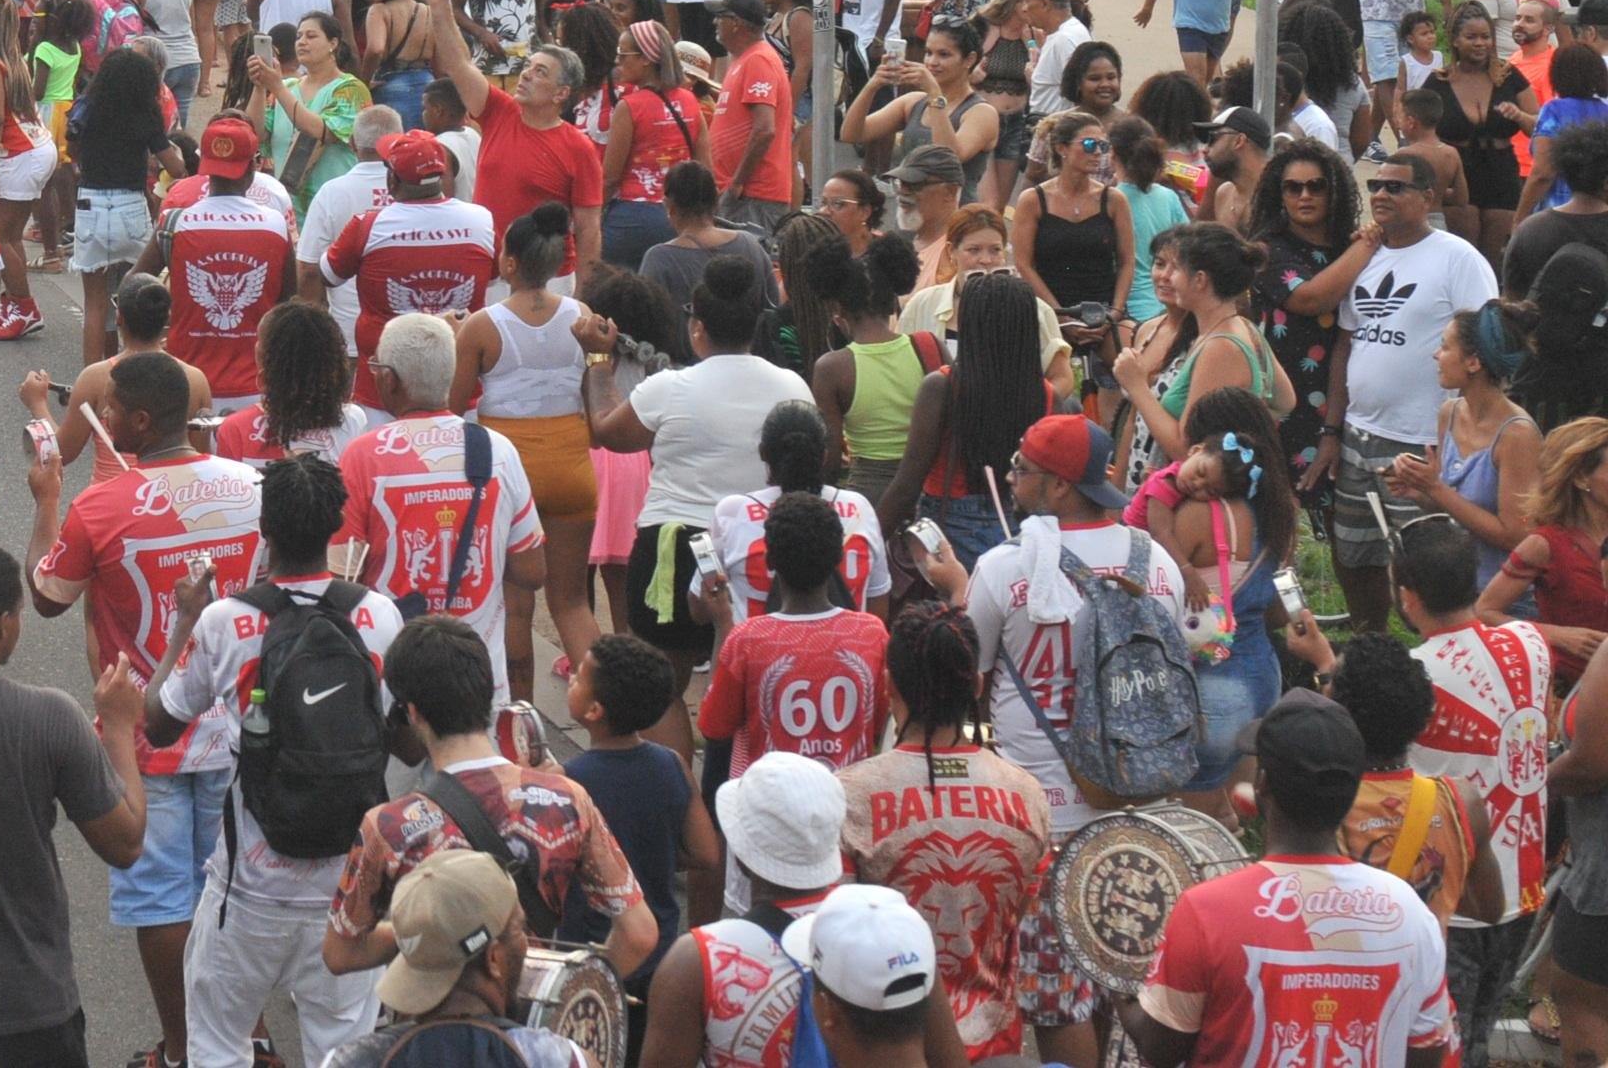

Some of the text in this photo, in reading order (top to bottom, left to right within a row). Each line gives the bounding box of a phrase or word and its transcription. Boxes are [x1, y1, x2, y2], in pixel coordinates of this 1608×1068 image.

[375, 423, 465, 456] Bater
[133, 474, 250, 517] Bateria
[404, 487, 486, 506] IMPERADORS
[779, 675, 858, 737] 60
[799, 738, 842, 755] Anos
[870, 786, 1033, 843] BATERIA
[1254, 872, 1398, 922] Bateria
[887, 952, 920, 970] FILA
[1282, 973, 1380, 991] IMPERADORES
